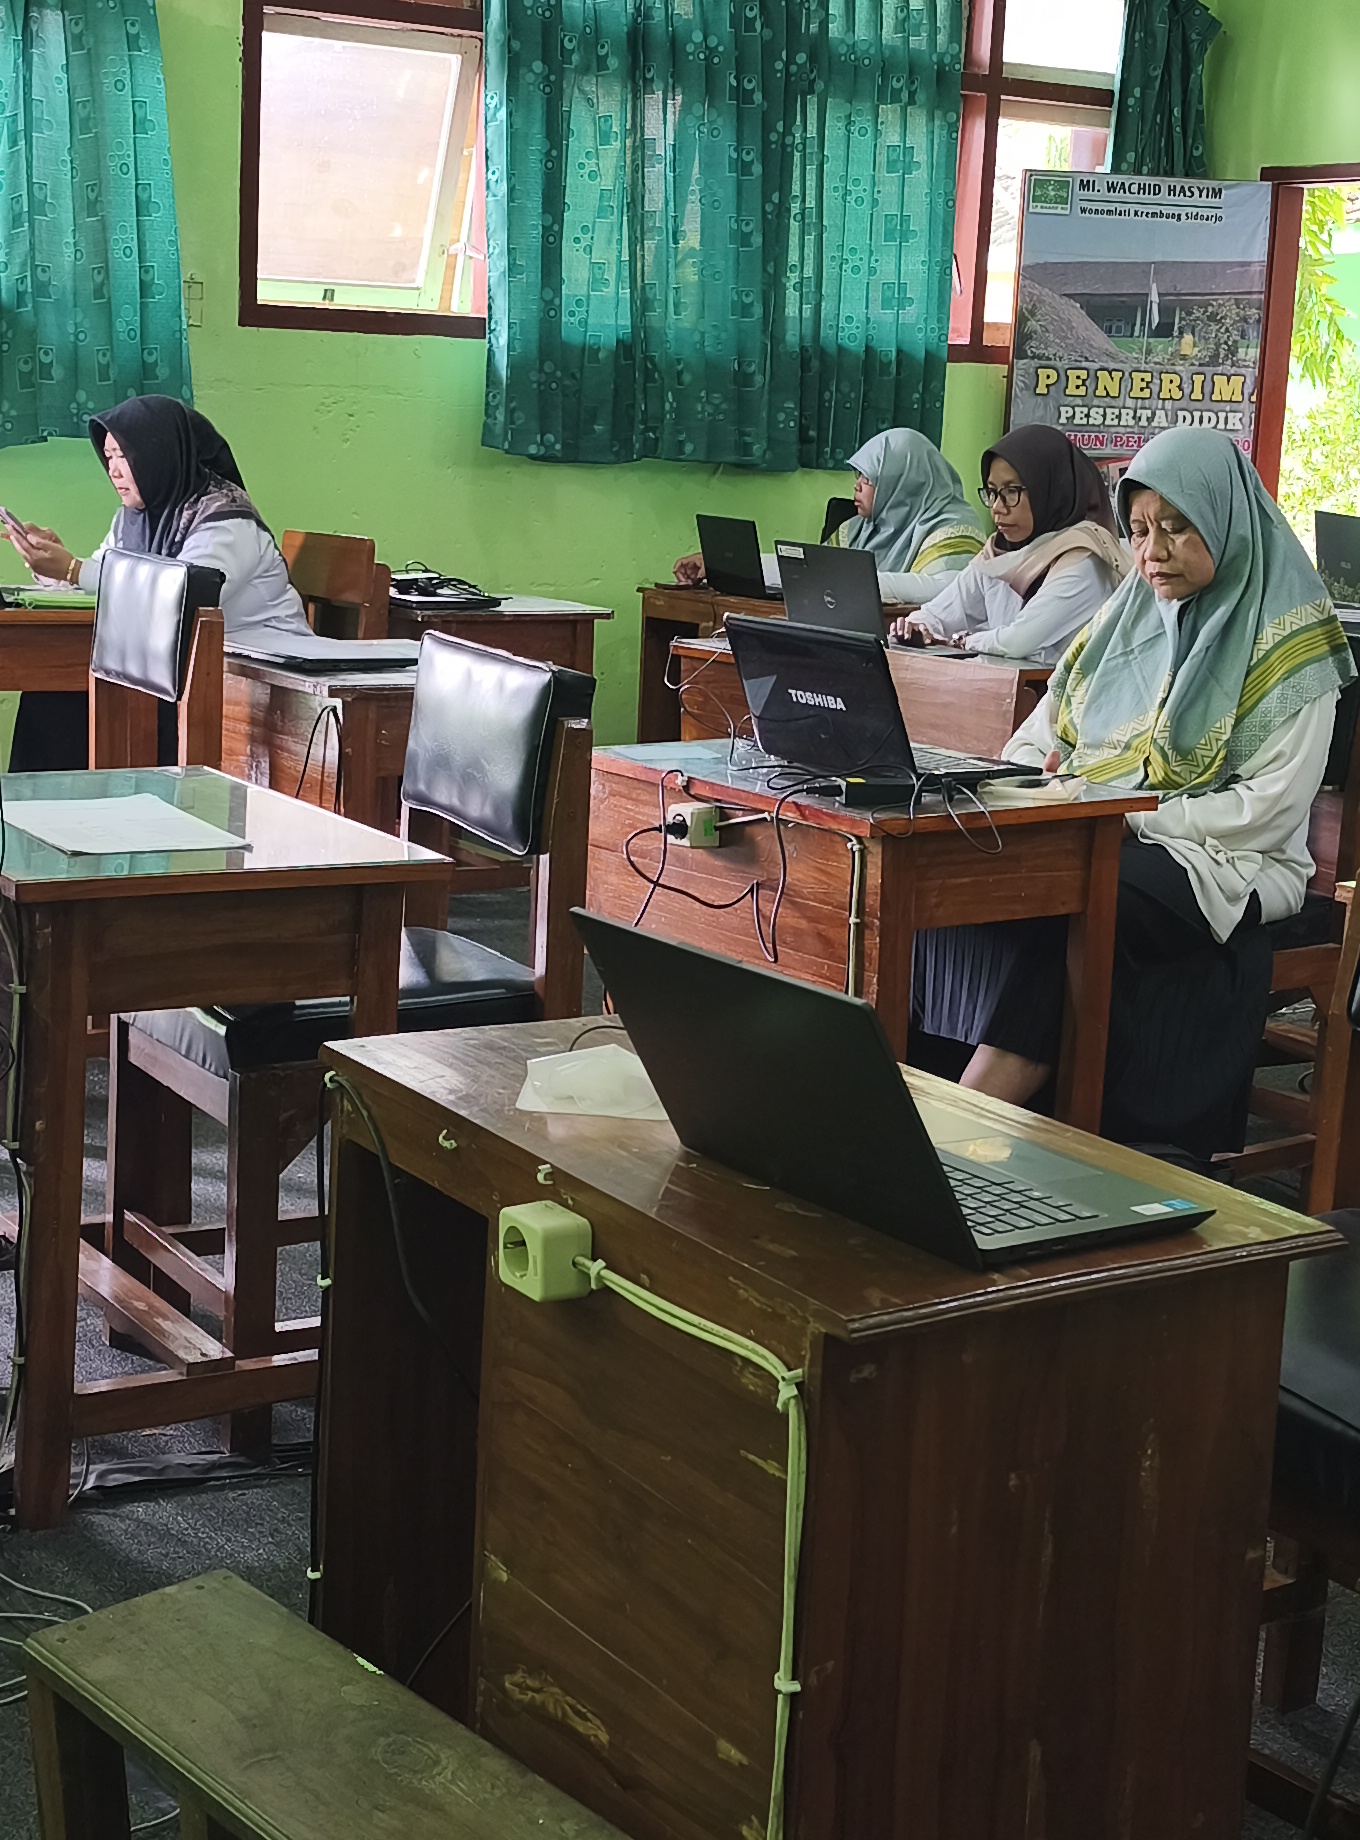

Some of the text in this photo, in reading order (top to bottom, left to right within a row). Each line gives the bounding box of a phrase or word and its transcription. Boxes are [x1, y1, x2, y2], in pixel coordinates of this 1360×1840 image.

[1078, 179, 1223, 200] MI. WACHID HASYIM
[1133, 208, 1182, 222] Krembung
[1184, 211, 1224, 225] Sidoarjo
[1035, 367, 1256, 402] PENERIM
[1058, 406, 1169, 428] PESERTA
[1176, 410, 1244, 430] DIDIK
[1066, 433, 1107, 449] HUN
[787, 688, 847, 712] TOSHIBA
